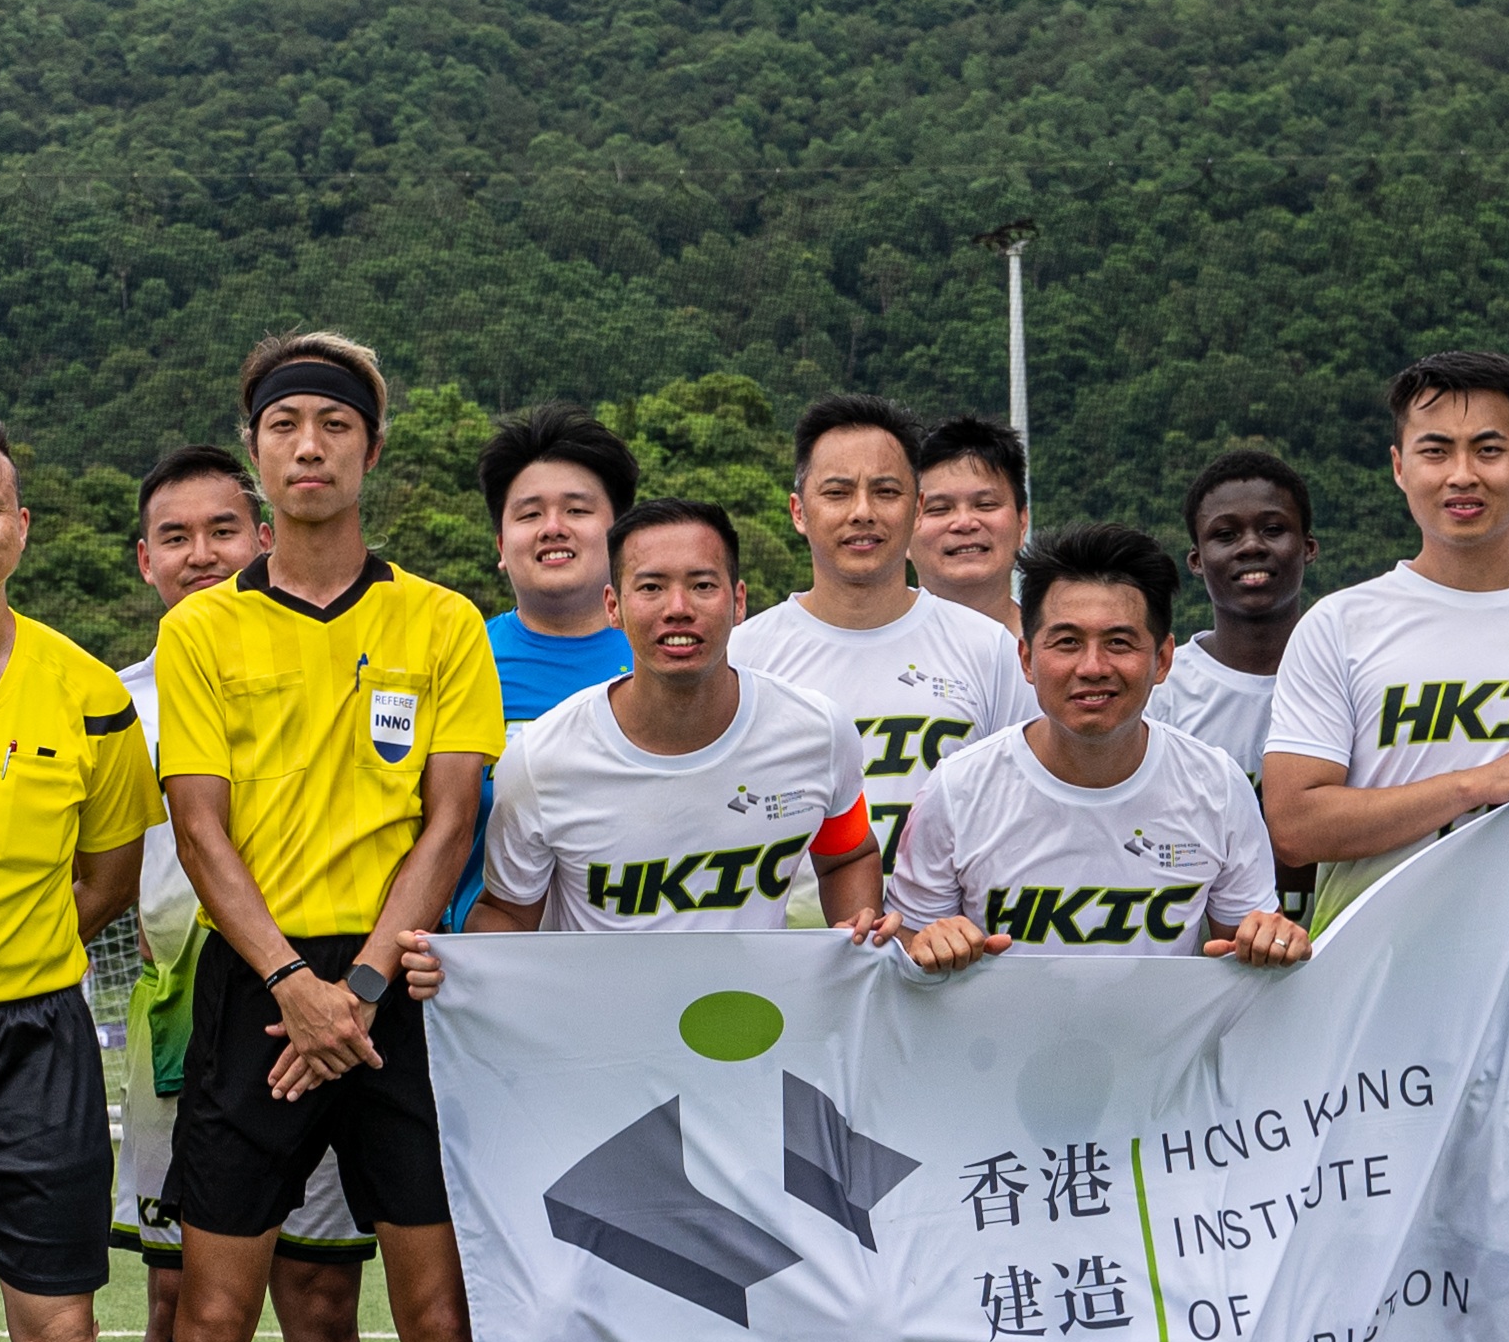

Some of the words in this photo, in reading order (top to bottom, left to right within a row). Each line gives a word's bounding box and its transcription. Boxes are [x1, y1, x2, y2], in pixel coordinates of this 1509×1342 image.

[375, 694, 414, 709] REFEREE
[375, 714, 411, 731] INNO
[587, 833, 811, 916] HKIC
[986, 884, 1203, 945] HKIC
[960, 1142, 1112, 1231] 香港
[973, 1255, 1134, 1342] 建造
[1188, 1295, 1251, 1341] OF
